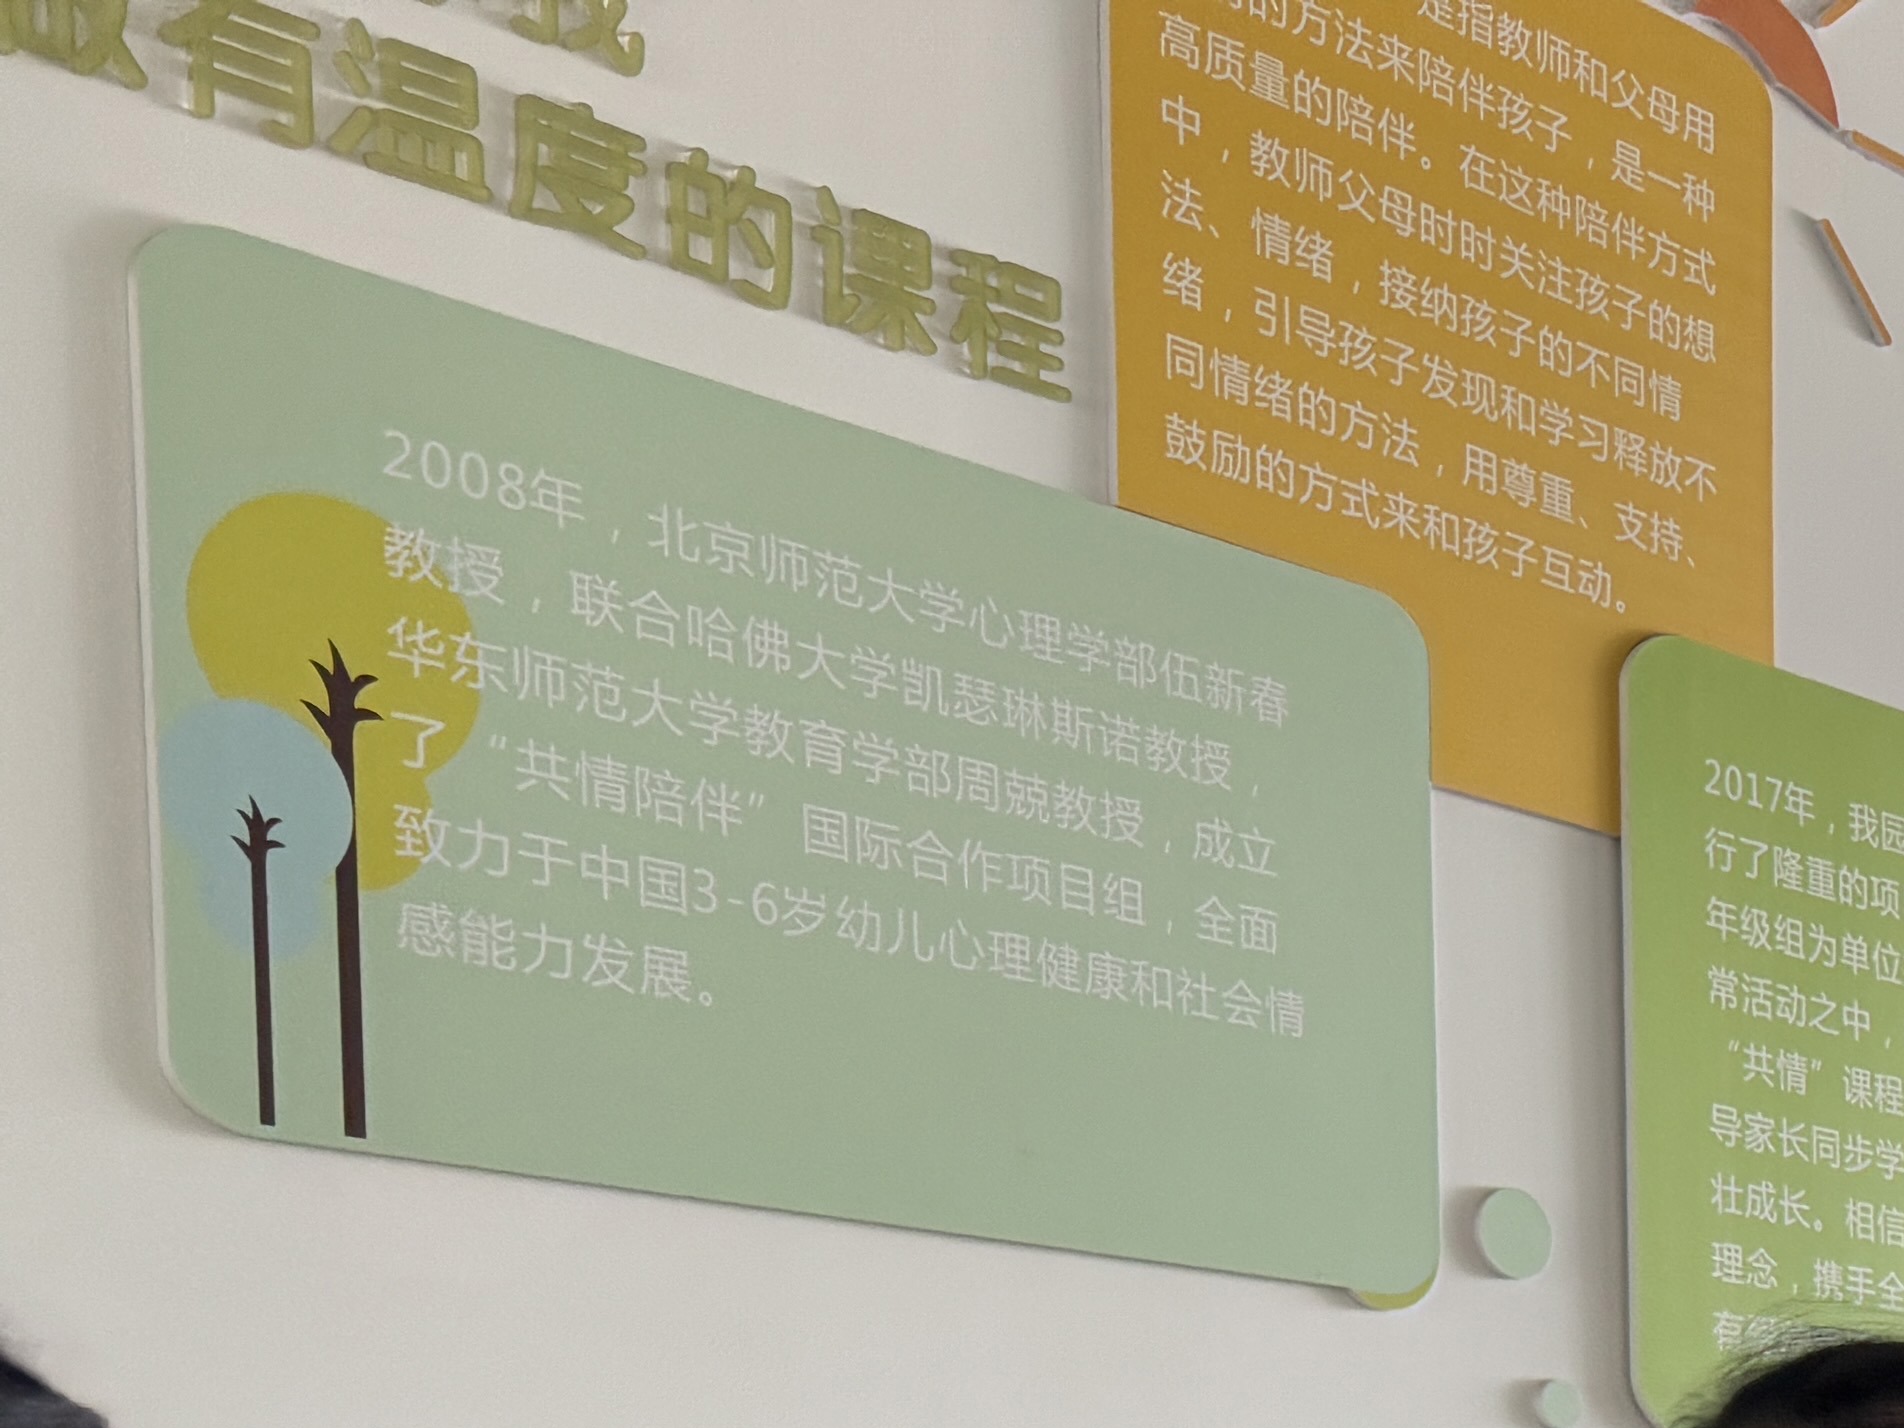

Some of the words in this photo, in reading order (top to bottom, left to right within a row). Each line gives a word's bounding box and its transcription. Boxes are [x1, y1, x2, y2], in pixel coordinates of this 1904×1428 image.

[1165, 413, 1626, 614] 鼓励的方式来和孩子互动。
[397, 900, 713, 1008] 感能力发展。
